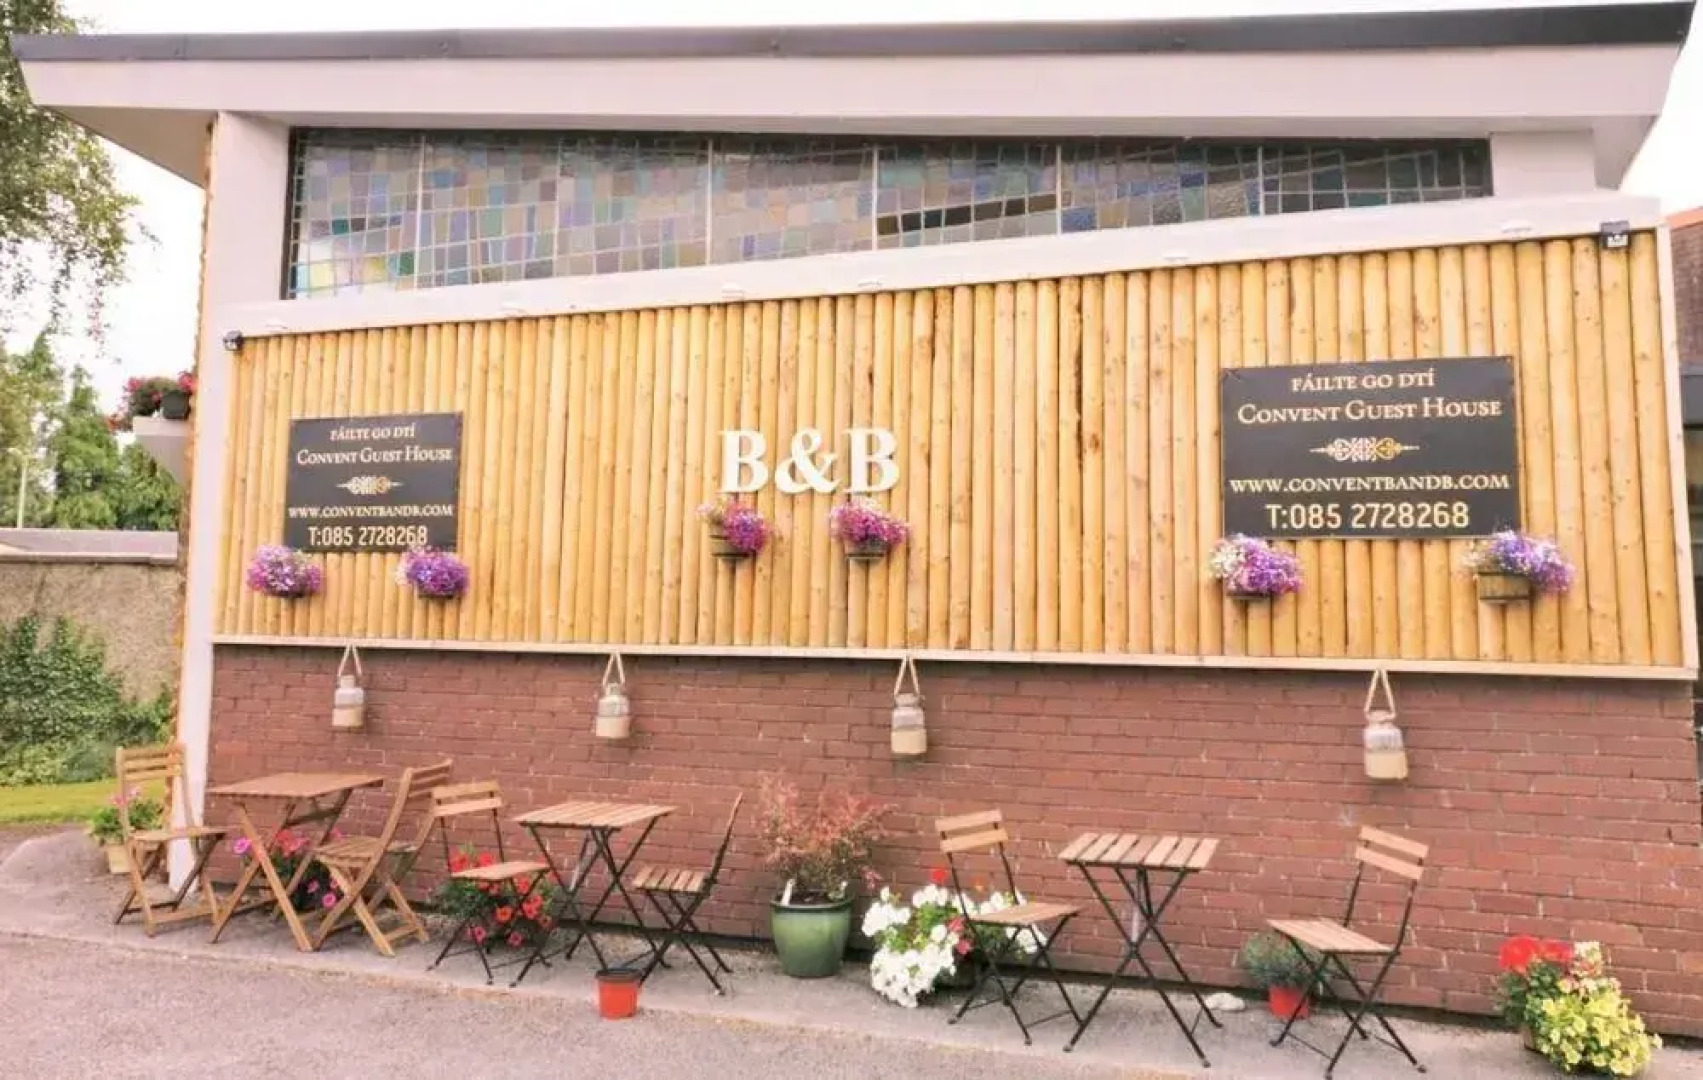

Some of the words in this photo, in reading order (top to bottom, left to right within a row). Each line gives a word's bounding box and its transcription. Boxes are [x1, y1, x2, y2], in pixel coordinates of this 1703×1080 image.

[1291, 373, 1360, 392] FÁILTE
[1362, 374, 1393, 389] GO
[1399, 368, 1435, 388] DTÍ
[1237, 403, 1340, 424] CONVENT
[1345, 400, 1417, 420] GUEST
[1422, 397, 1502, 418] HOUSE
[371, 427, 391, 439] GO
[297, 449, 356, 465] CONVENT
[360, 447, 402, 463] GUEST
[405, 445, 453, 461] HOUSE
[718, 427, 900, 493] B&B
[1229, 474, 1510, 493] WWW.CONVENTBANDB.COM
[1265, 503, 1341, 529] T:085
[1351, 502, 1470, 529] 2728268
[308, 526, 353, 546] T:085
[358, 525, 428, 546] 2728268
